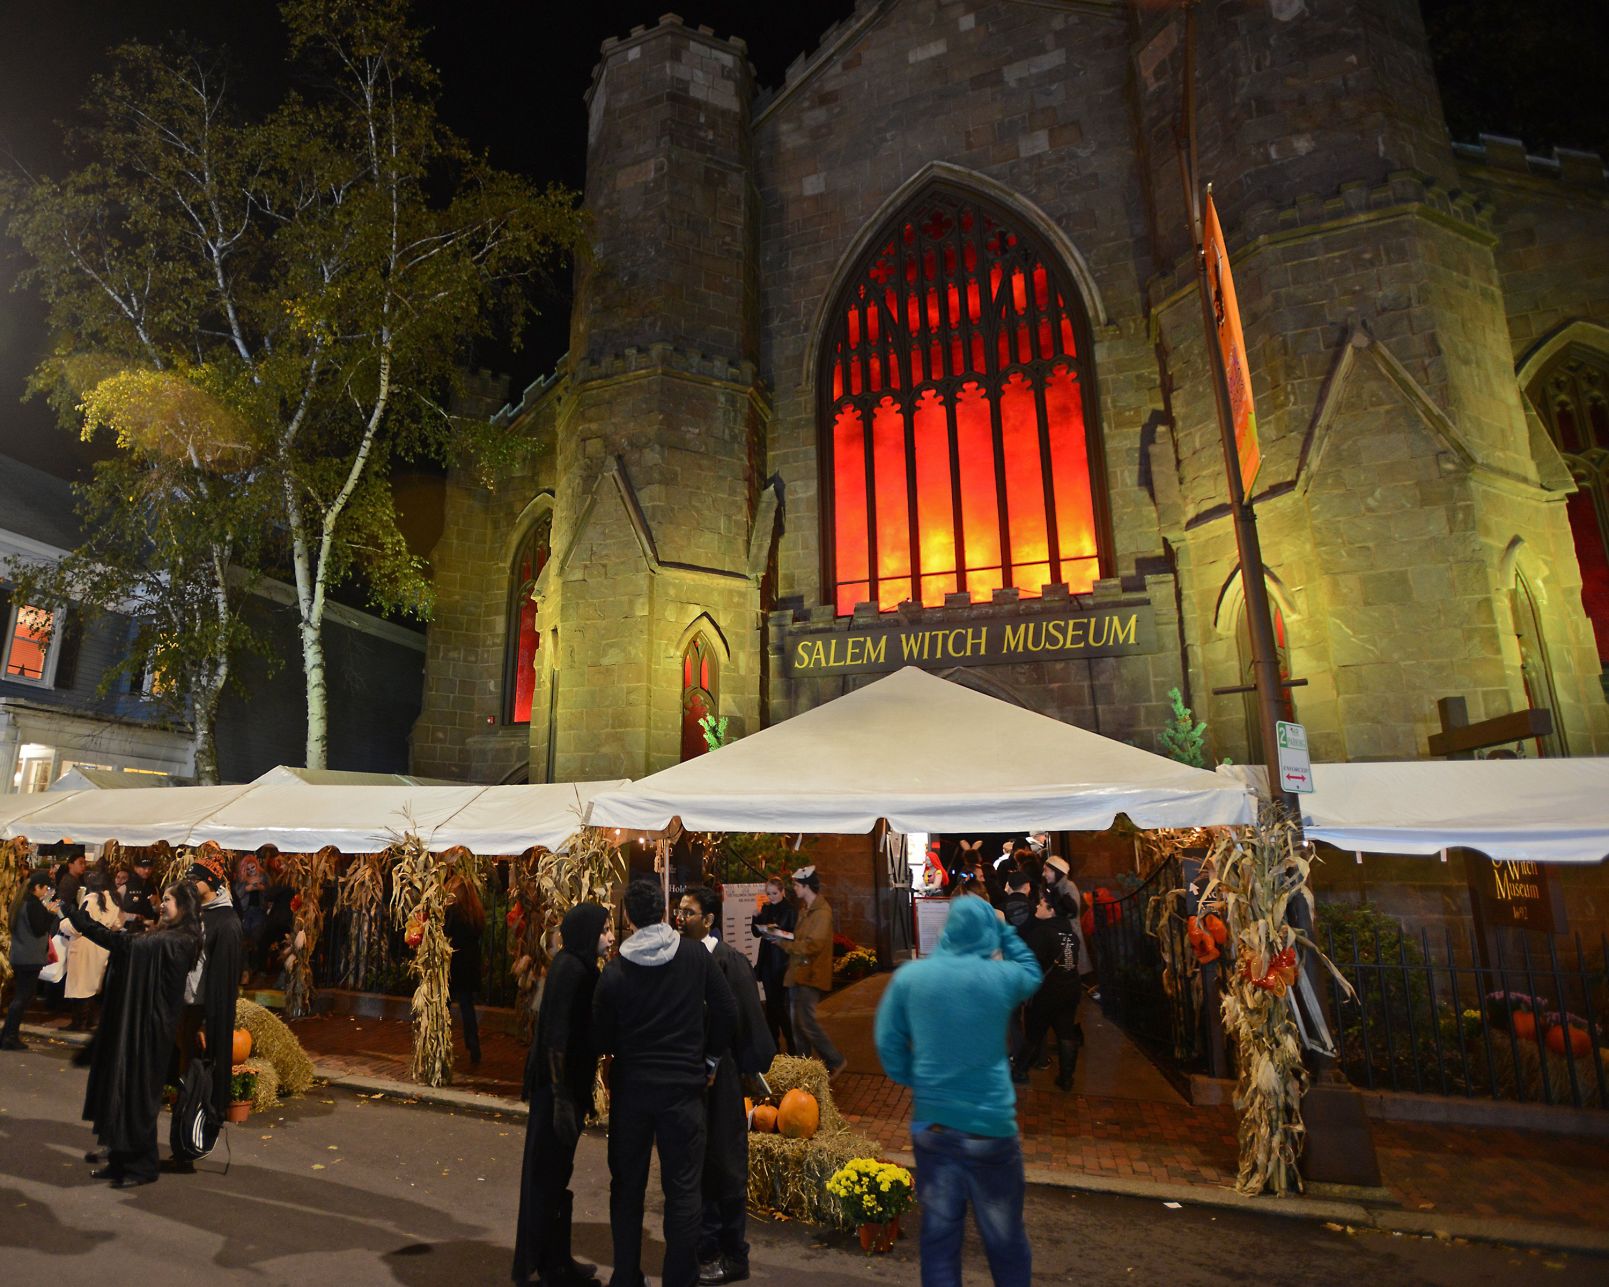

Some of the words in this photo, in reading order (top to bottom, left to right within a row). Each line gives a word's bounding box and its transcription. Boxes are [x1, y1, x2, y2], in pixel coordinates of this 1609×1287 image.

[794, 635, 887, 669] SALEM
[900, 626, 988, 661] WITCH
[1002, 614, 1138, 654] MUSEUM
[1493, 869, 1540, 900] Museum
